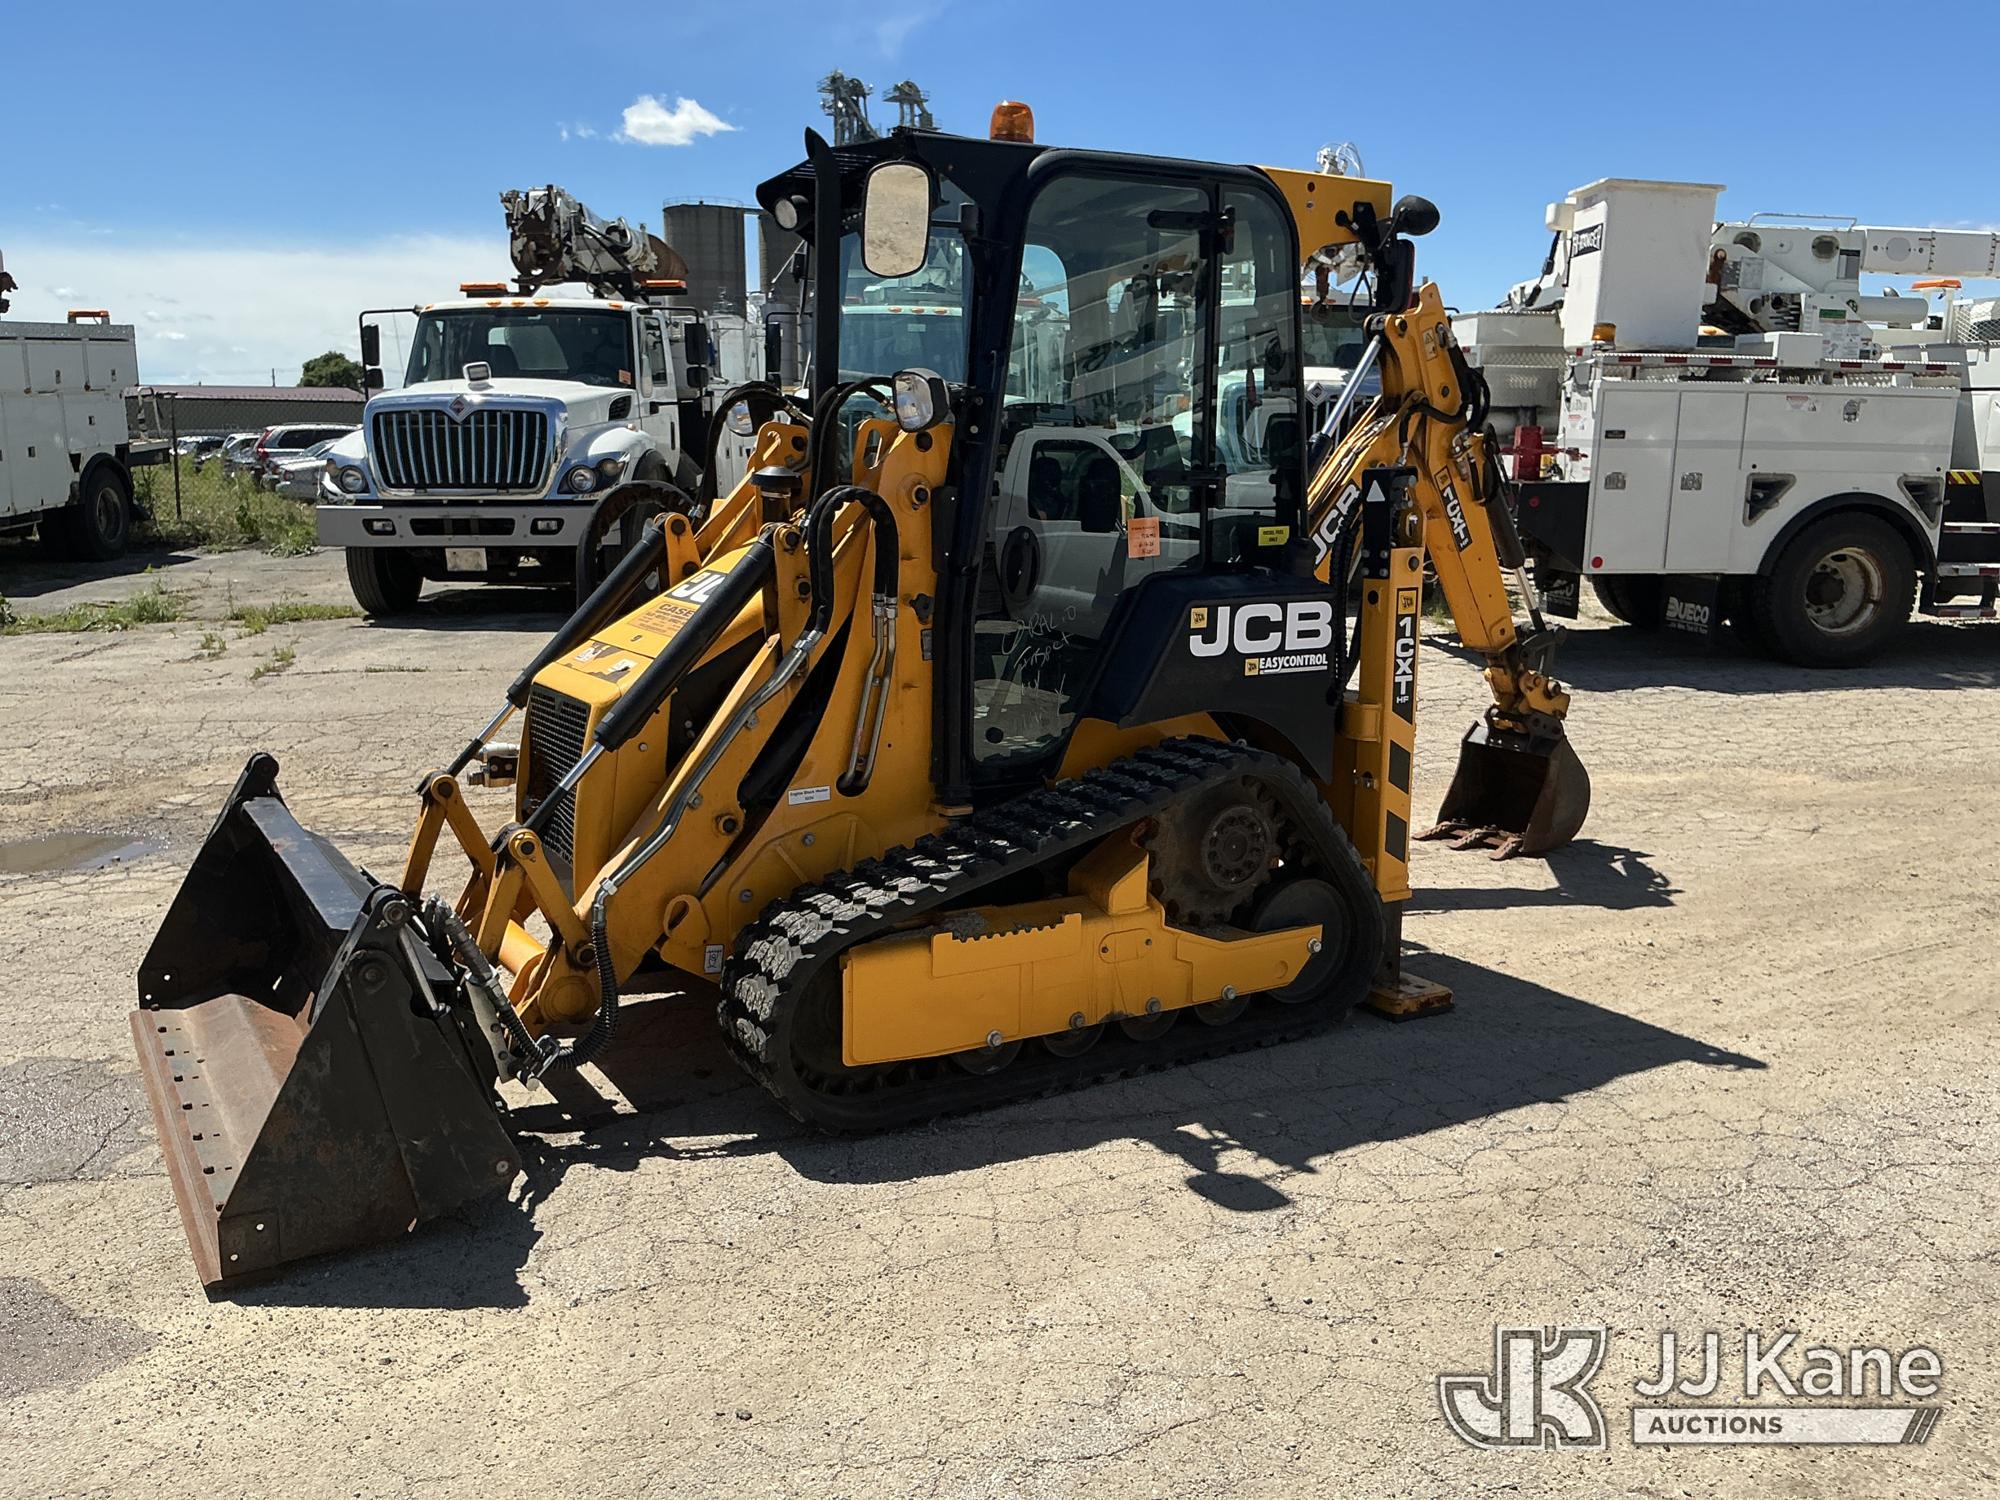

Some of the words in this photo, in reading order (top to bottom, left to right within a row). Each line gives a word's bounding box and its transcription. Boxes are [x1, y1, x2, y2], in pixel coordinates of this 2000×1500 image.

[1190, 601, 1332, 657] JCB
[1666, 596, 1710, 624] DUECO
[1259, 653, 1329, 672] EASYCONTROL
[1395, 616, 1415, 695] 1CXT
